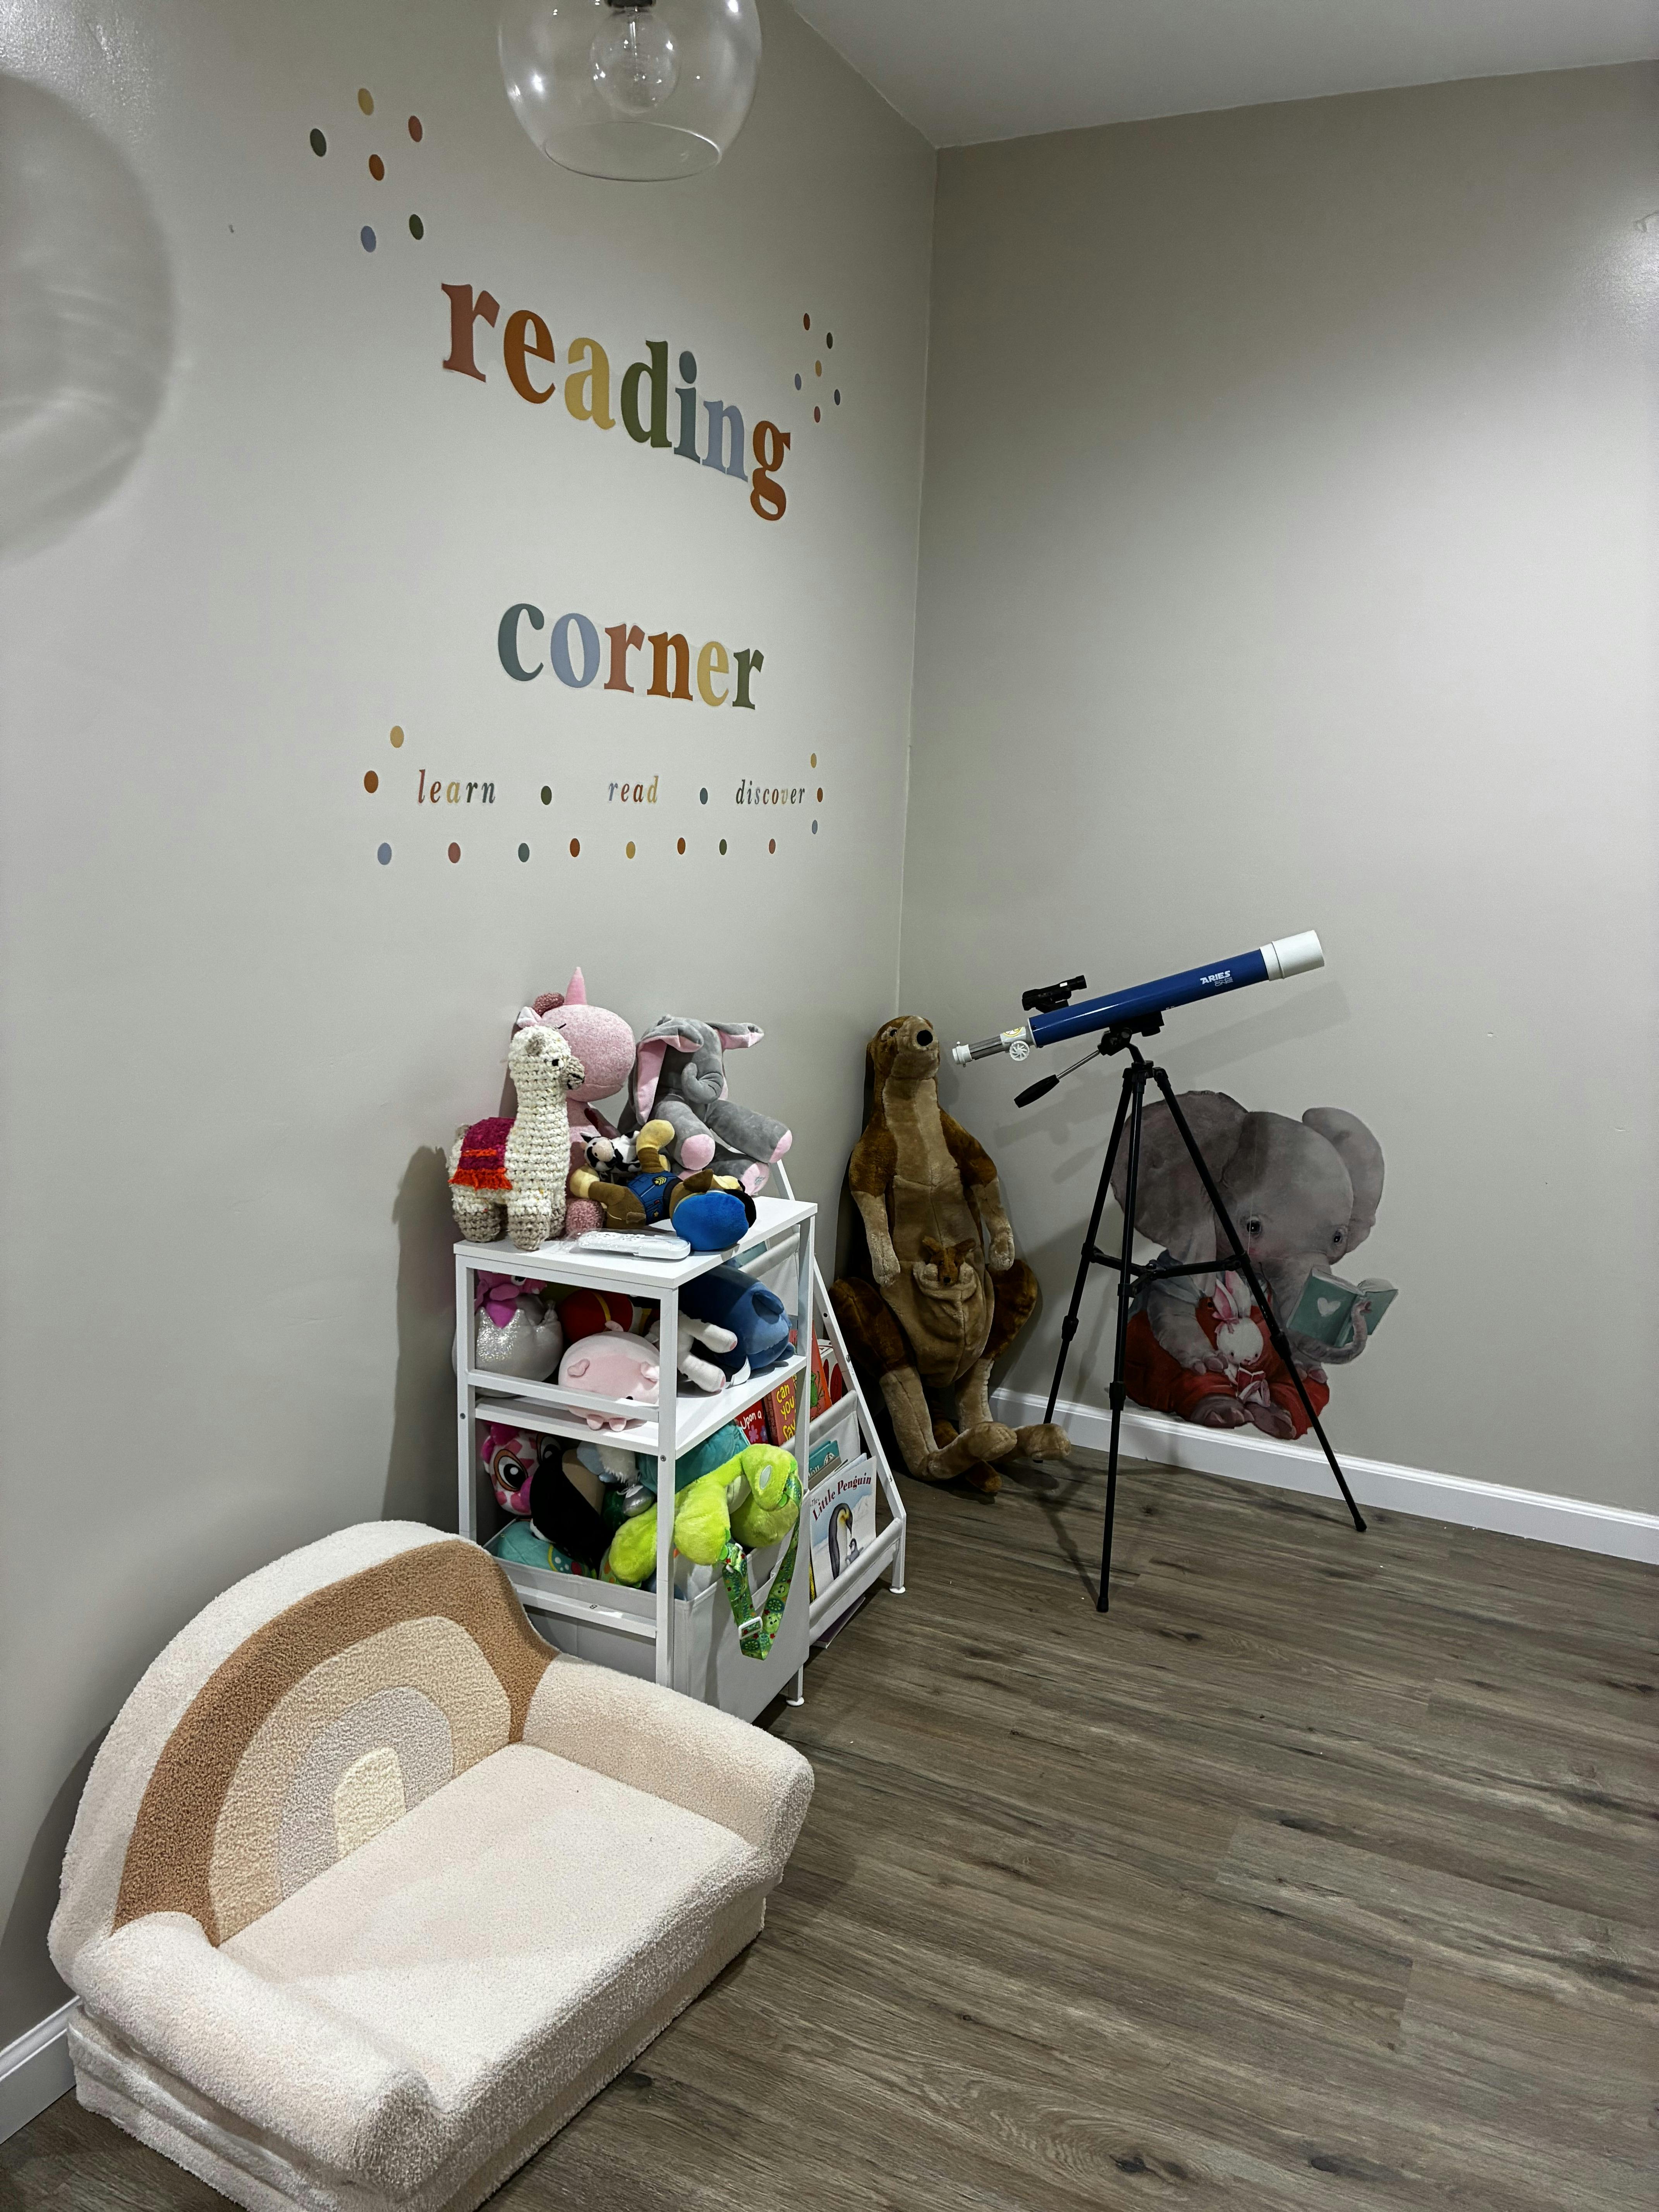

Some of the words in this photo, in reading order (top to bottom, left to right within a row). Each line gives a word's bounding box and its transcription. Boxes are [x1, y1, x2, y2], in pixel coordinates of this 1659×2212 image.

[440, 281, 791, 521] reading
[497, 603, 764, 711] corner
[417, 769, 496, 804] learn
[608, 775, 659, 804] read
[735, 779, 806, 805] discover
[1200, 970, 1231, 984] ARIES
[776, 1384, 790, 1404] can
[780, 1395, 795, 1421] you
[740, 1412, 756, 1430] Upon
[812, 1489, 836, 1522] Little
[837, 1472, 872, 1495] Penguin
